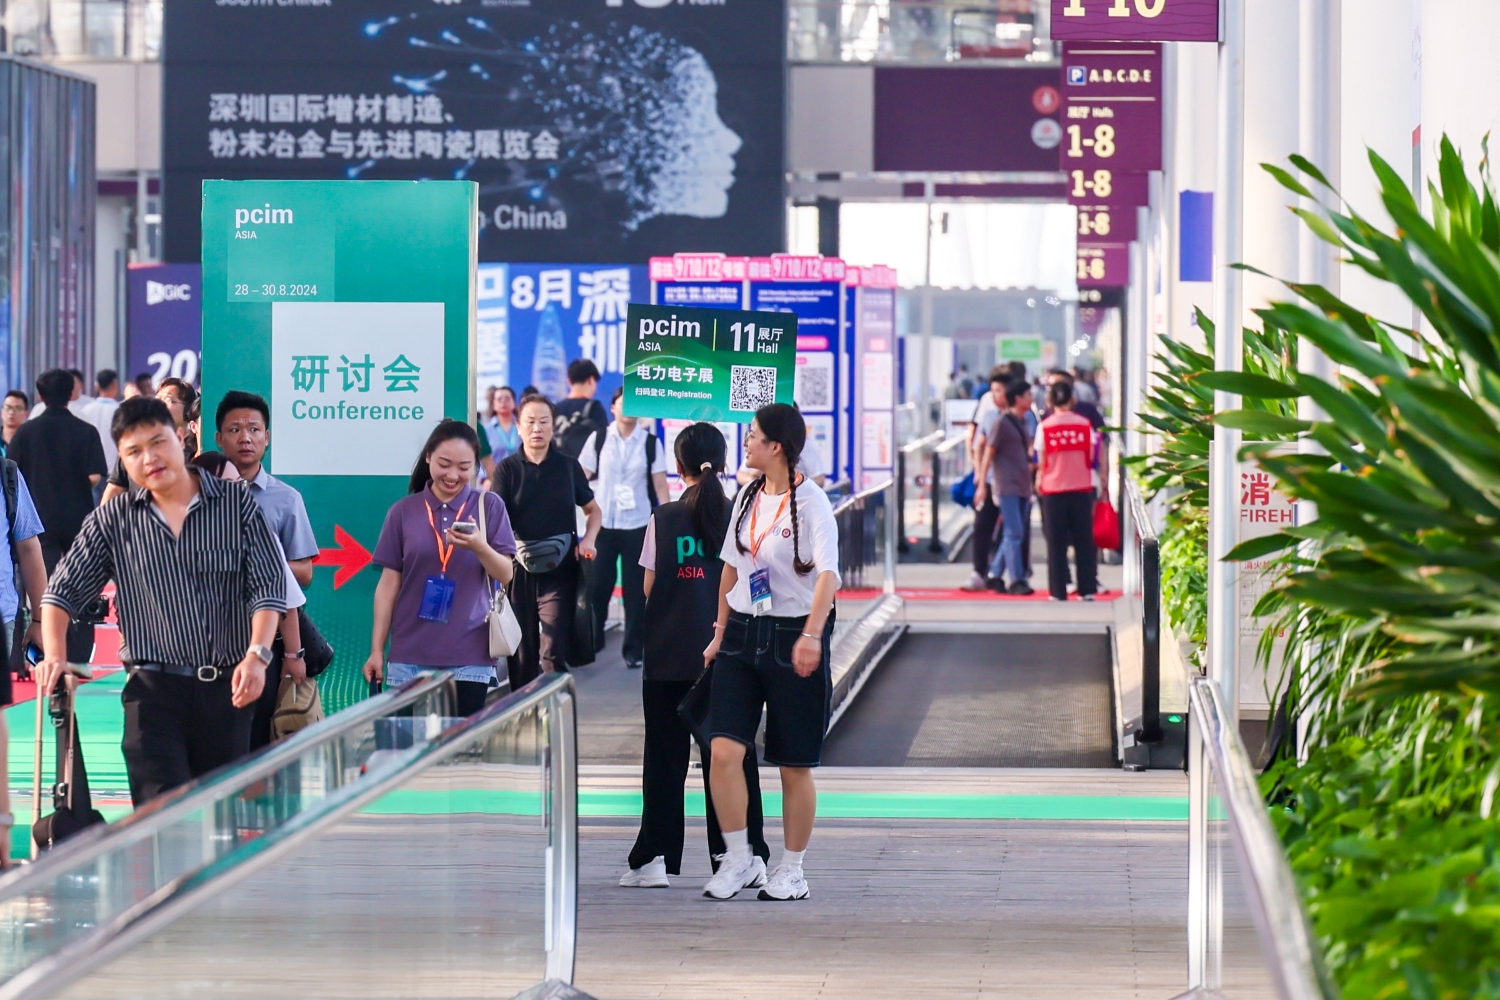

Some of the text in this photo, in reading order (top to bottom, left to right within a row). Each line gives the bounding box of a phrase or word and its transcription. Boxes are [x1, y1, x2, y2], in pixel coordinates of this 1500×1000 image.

[209, 129, 561, 159] 粉末冶金与先进陶瓷展览会
[1067, 124, 1116, 158] 1-8
[1071, 169, 1112, 197] 1-8
[235, 203, 293, 228] pcim
[494, 204, 567, 230] China
[1078, 212, 1111, 236] 1-8
[235, 231, 257, 240] ASIA
[235, 284, 248, 295] 28
[262, 284, 318, 296] 30.8.2024
[511, 269, 572, 311] 8月
[578, 268, 632, 376] 深圳
[639, 315, 700, 339] pcim
[757, 327, 784, 341] 展厅
[637, 342, 662, 351] ASIA
[730, 322, 755, 353] 11
[757, 342, 778, 354] Hall
[147, 349, 201, 391] 20
[291, 353, 421, 393] 研讨会
[636, 364, 714, 384] 电力电子展
[635, 387, 712, 399] 扫码登记 Registration
[291, 400, 425, 420] Conference
[677, 567, 705, 578] ASIA
